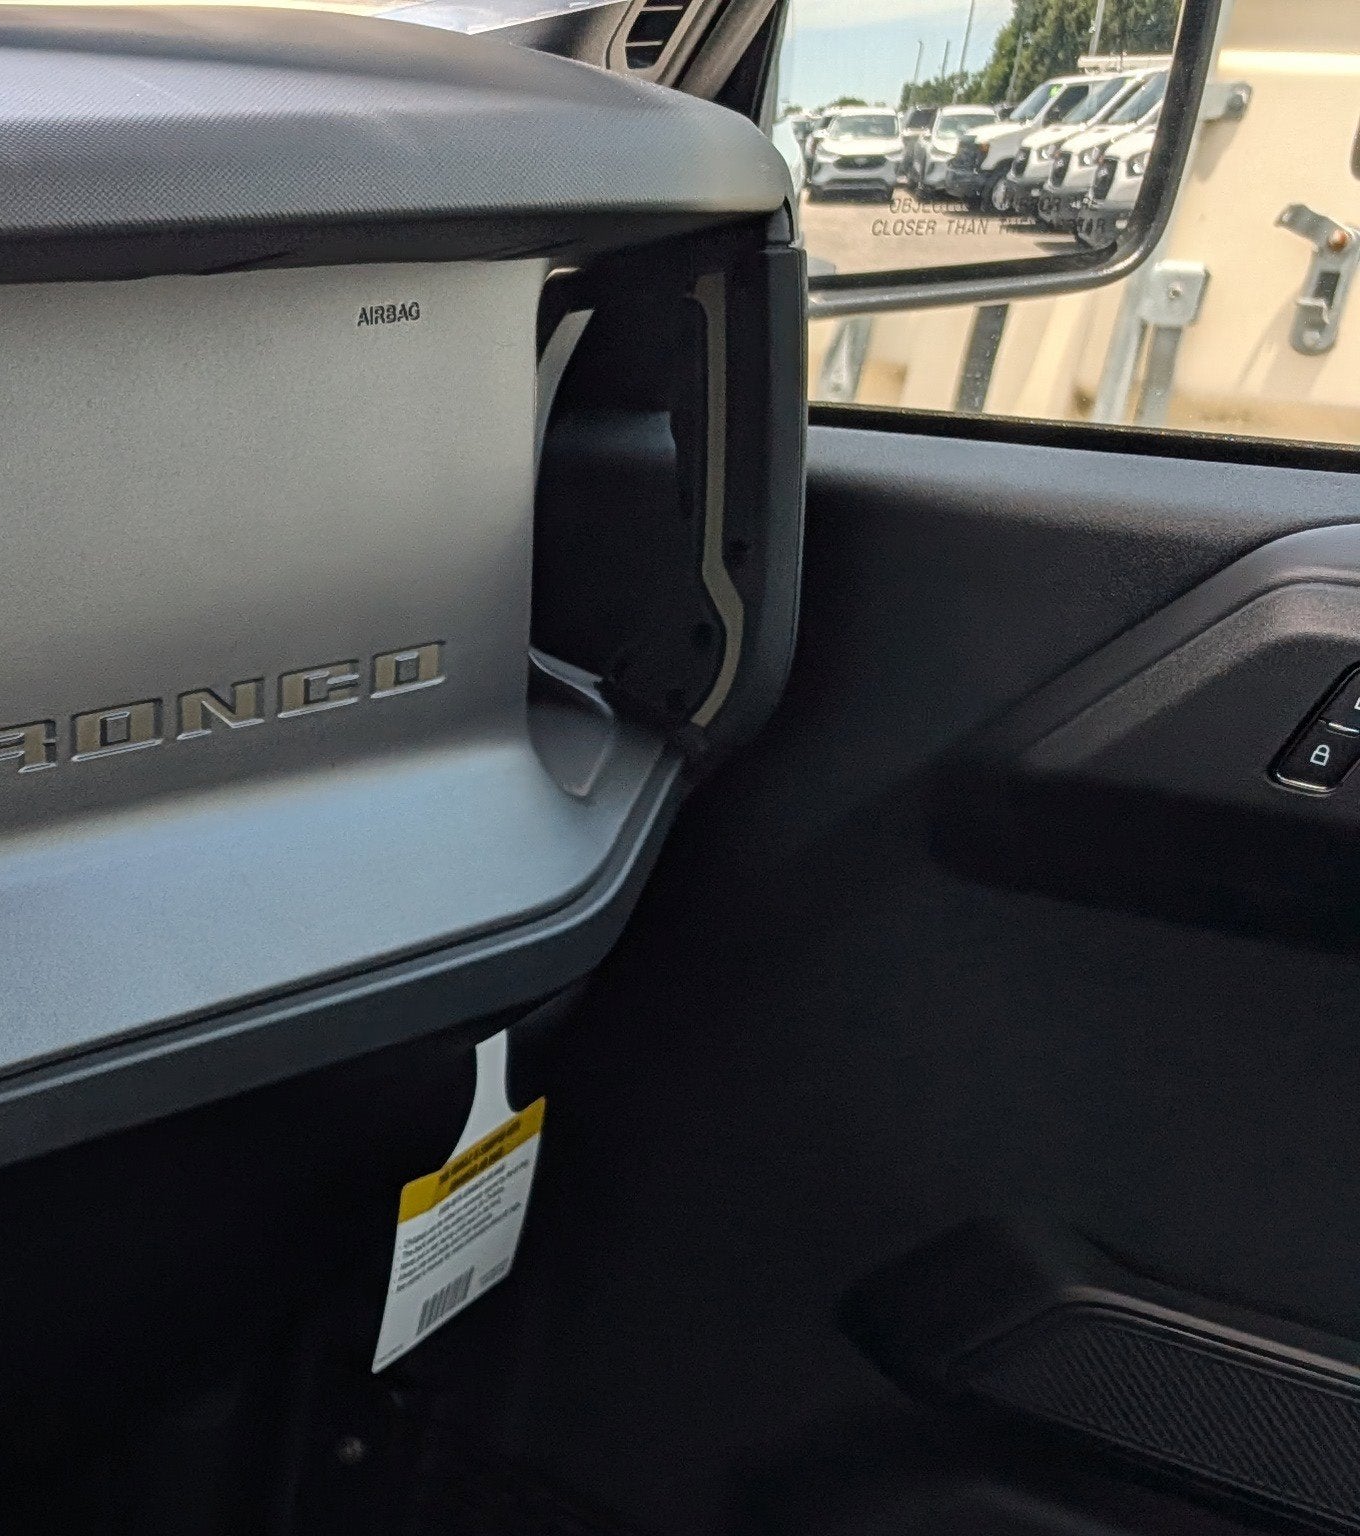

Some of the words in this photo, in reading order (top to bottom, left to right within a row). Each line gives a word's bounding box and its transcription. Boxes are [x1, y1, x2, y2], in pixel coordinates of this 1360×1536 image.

[871, 218, 937, 236] CLOSER
[946, 218, 989, 236] THAN
[357, 302, 421, 327] AIRBAG
